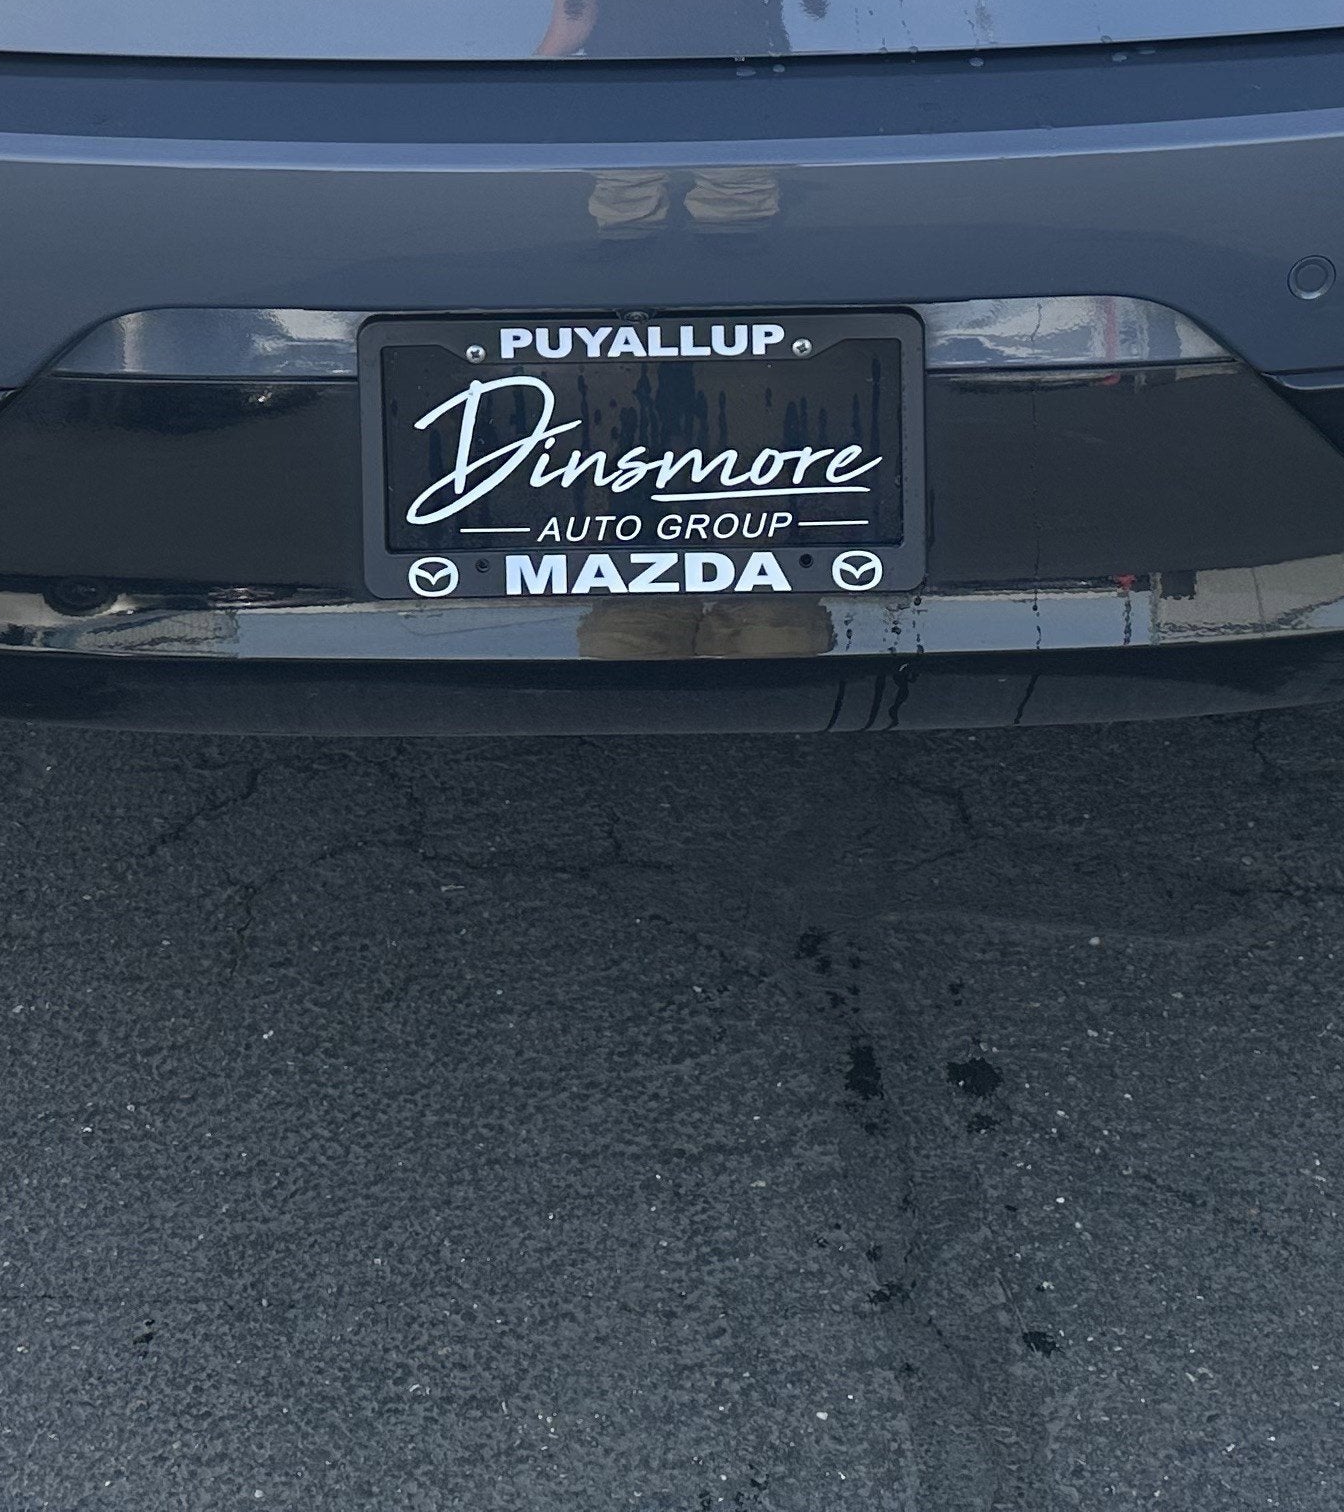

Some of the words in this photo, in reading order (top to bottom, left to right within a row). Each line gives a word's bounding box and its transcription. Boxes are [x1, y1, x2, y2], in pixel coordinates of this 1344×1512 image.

[500, 324, 785, 359] PUYALLUP
[406, 375, 883, 525] Dinsmore
[536, 514, 643, 543] AUTO
[656, 512, 793, 540] GROUP
[505, 551, 792, 596] MAZDA
